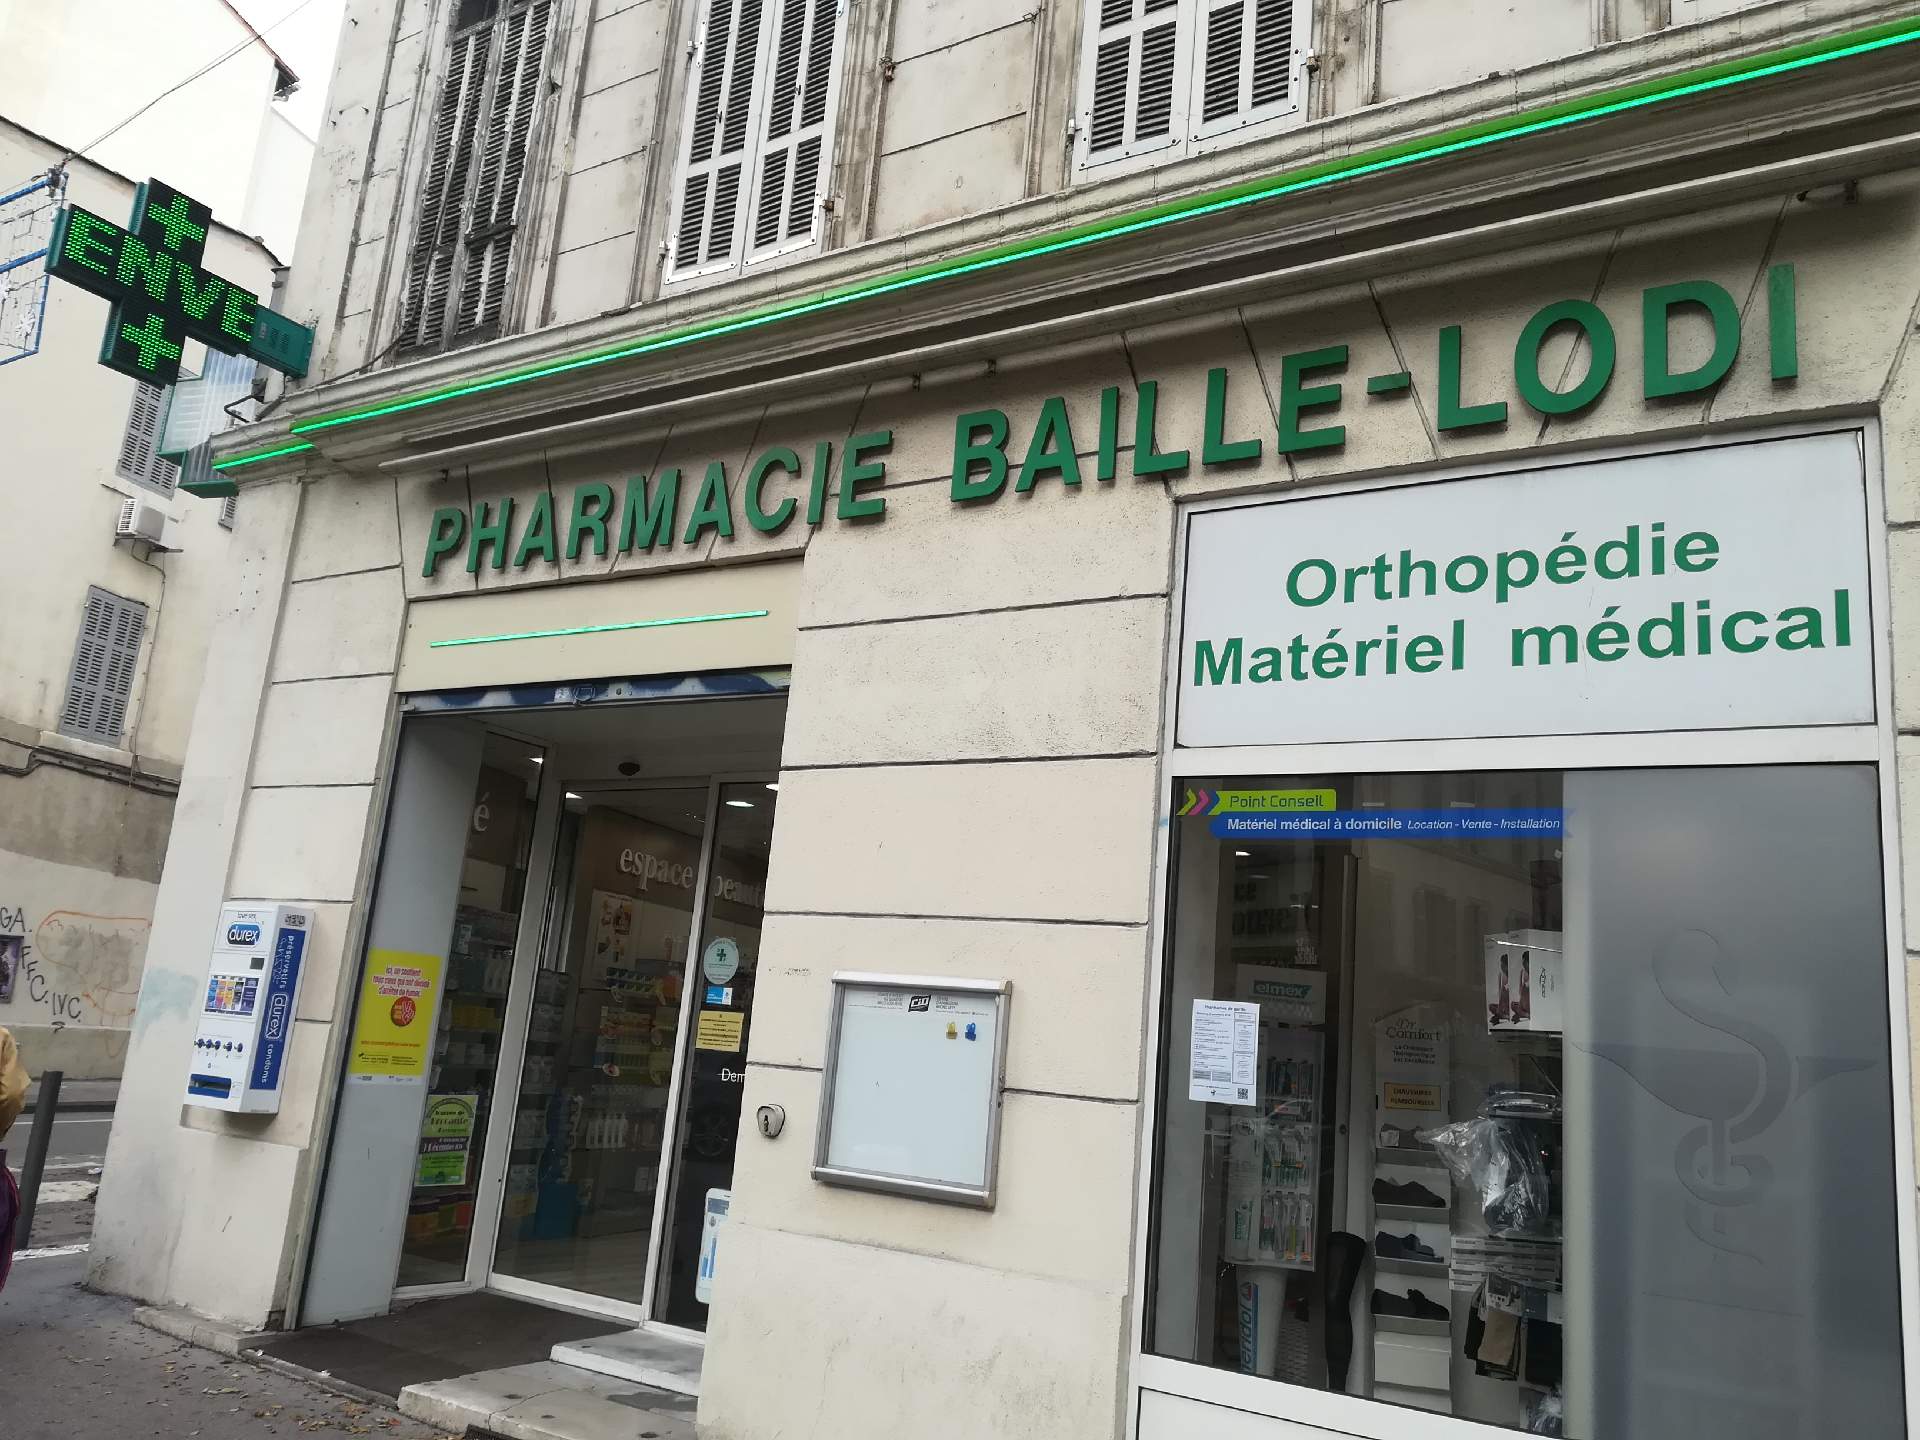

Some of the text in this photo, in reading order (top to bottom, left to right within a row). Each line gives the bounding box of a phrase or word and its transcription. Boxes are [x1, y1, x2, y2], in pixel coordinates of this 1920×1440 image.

[64, 209, 257, 342] ENVE
[422, 264, 1800, 578] PHARMACIE BAILLE-LODI
[1286, 521, 1721, 607] Orthopédie
[1193, 588, 1852, 687] Matériel médical
[1229, 794, 1325, 809] Point Conseil
[1226, 817, 1278, 831] Matériel
[1284, 817, 1332, 831] médical
[1333, 817, 1342, 831] à
[1344, 817, 1403, 831] domicile
[1406, 818, 1453, 830] Location
[1460, 818, 1492, 830] Vente
[1500, 817, 1561, 831] Installation
[618, 847, 697, 892] espace
[228, 925, 258, 944] durex
[1255, 981, 1306, 998] elmex
[265, 996, 287, 1038] durex
[1385, 1025, 1441, 1042] Comfort
[261, 1043, 274, 1084] condoms
[1239, 1303, 1252, 1372] eridol
